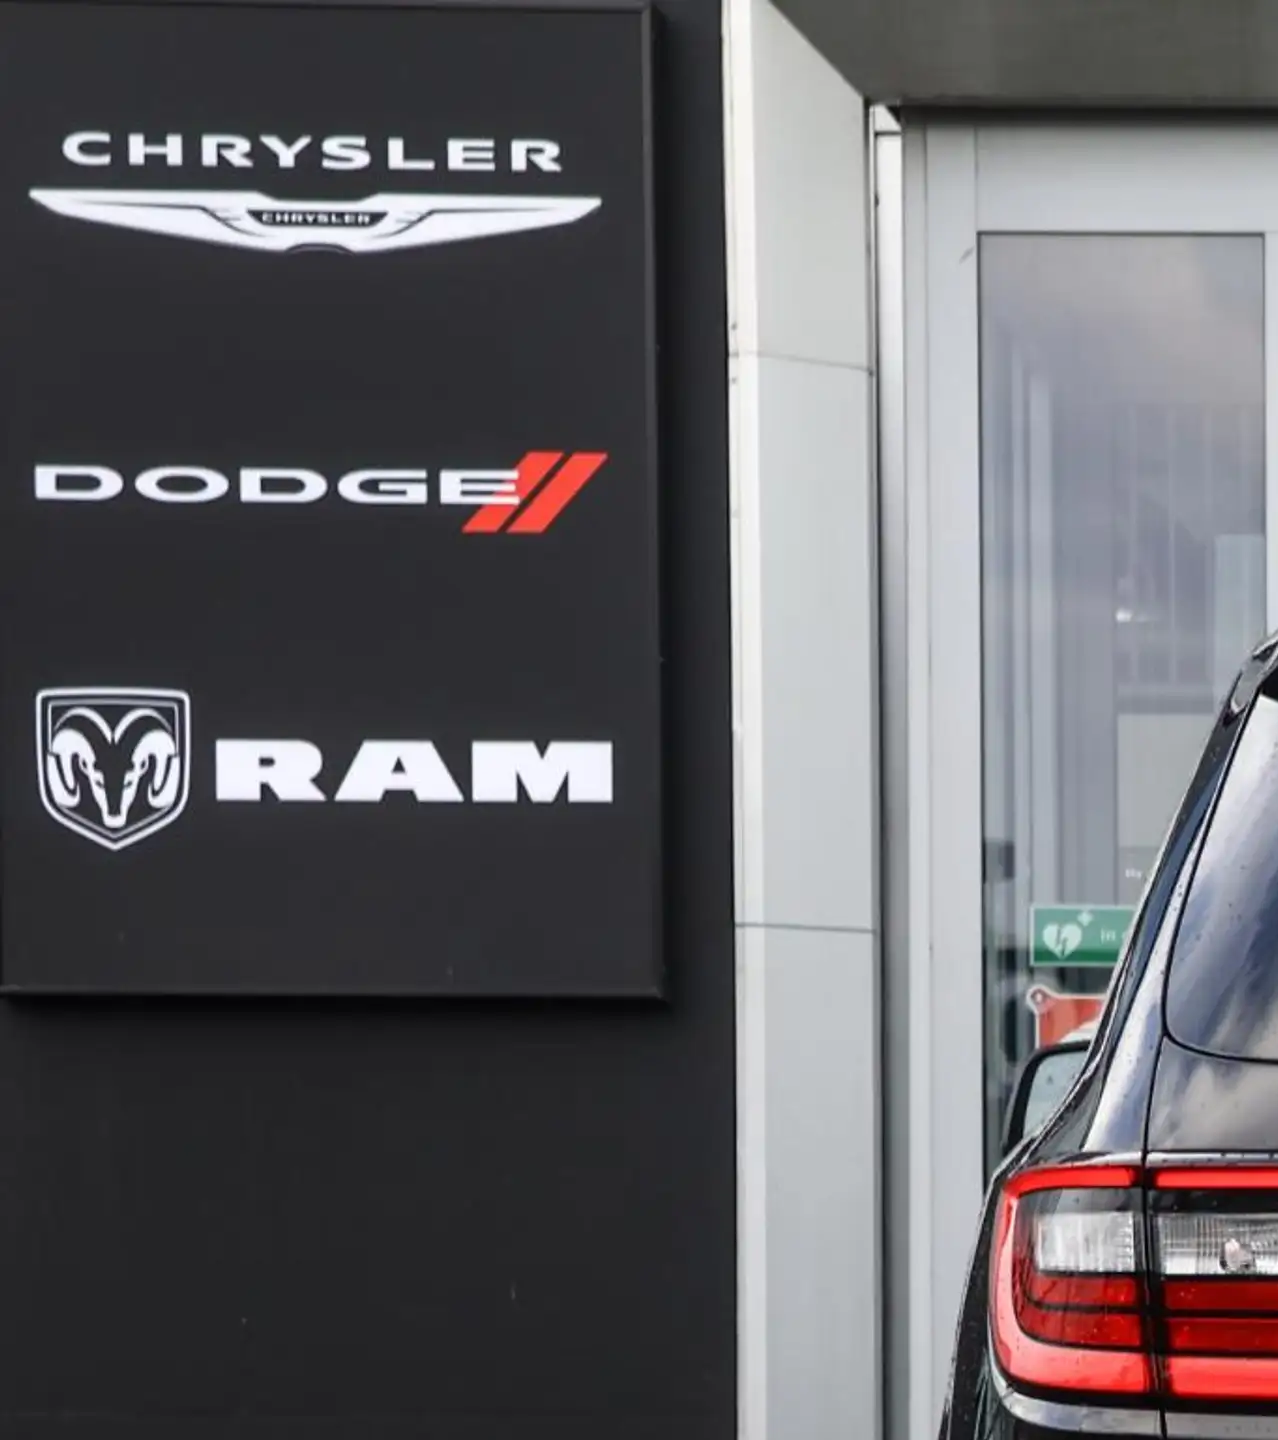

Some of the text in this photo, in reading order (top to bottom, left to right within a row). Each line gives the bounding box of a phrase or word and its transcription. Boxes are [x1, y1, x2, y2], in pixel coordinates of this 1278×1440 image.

[62, 131, 562, 172] CHRYSLER
[262, 210, 371, 224] CHRYSLER
[34, 464, 521, 505] DODGE
[215, 738, 614, 803] RAM
